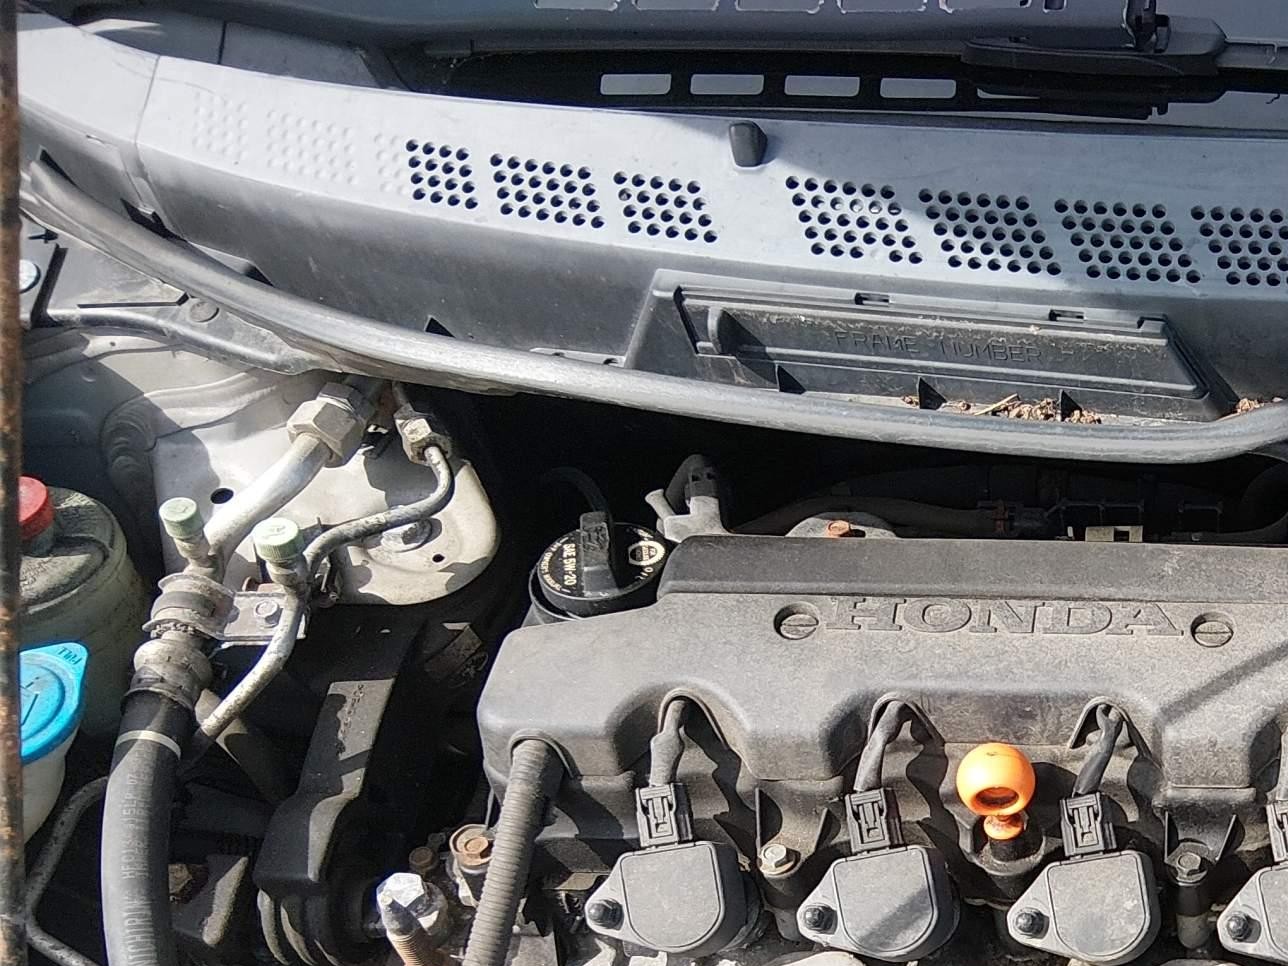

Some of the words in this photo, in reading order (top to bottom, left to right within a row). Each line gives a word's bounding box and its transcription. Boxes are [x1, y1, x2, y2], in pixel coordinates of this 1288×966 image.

[937, 337, 1043, 363] NUMBER
[562, 543, 577, 557] SAE
[563, 558, 578, 586] 5W-20
[825, 597, 1184, 636] HONDA
